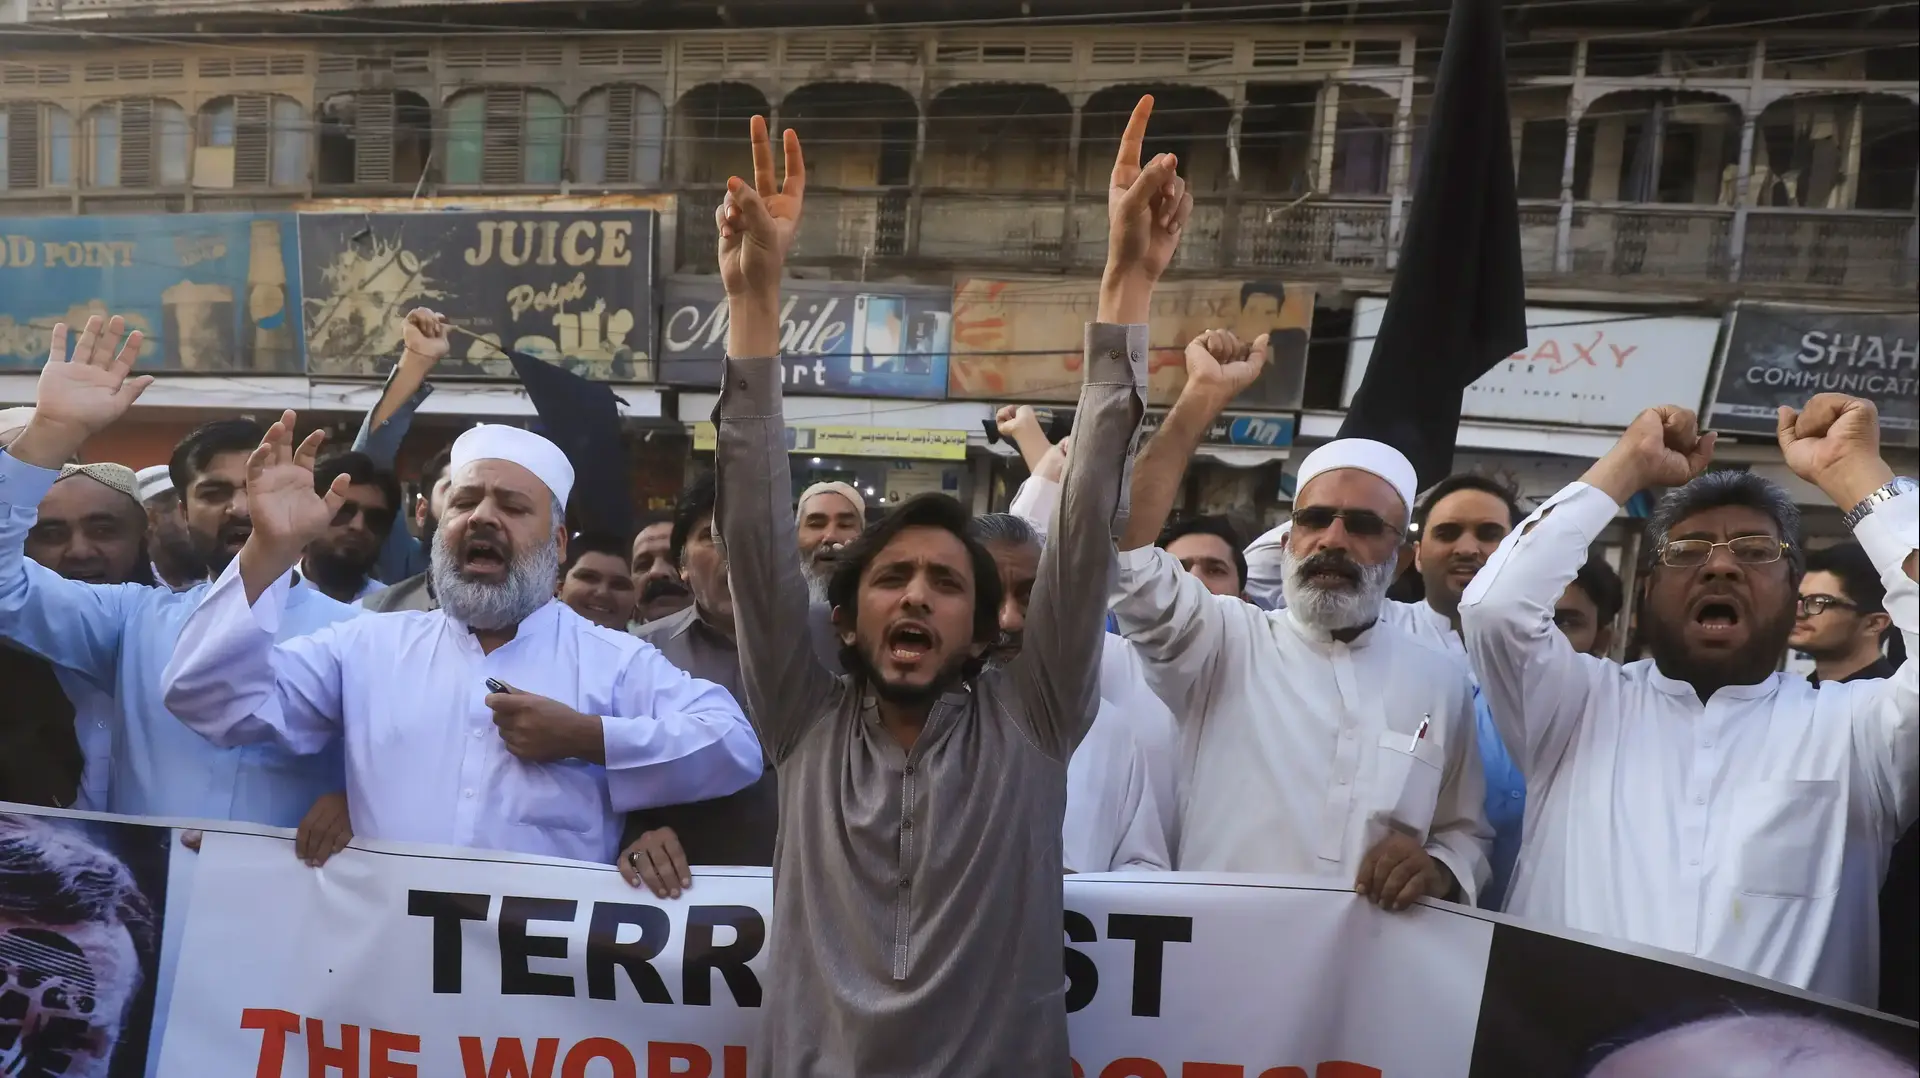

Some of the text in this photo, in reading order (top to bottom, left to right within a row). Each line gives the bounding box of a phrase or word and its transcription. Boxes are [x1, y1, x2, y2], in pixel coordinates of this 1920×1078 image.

[0, 234, 135, 269] D POINT
[464, 220, 632, 266] JUICE
[506, 272, 587, 322] Point
[665, 294, 846, 354] Mbile
[780, 359, 826, 386] rt
[1798, 331, 1918, 370] SHAH
[408, 889, 1193, 1018] TERRST
[240, 1008, 420, 1078] THE
